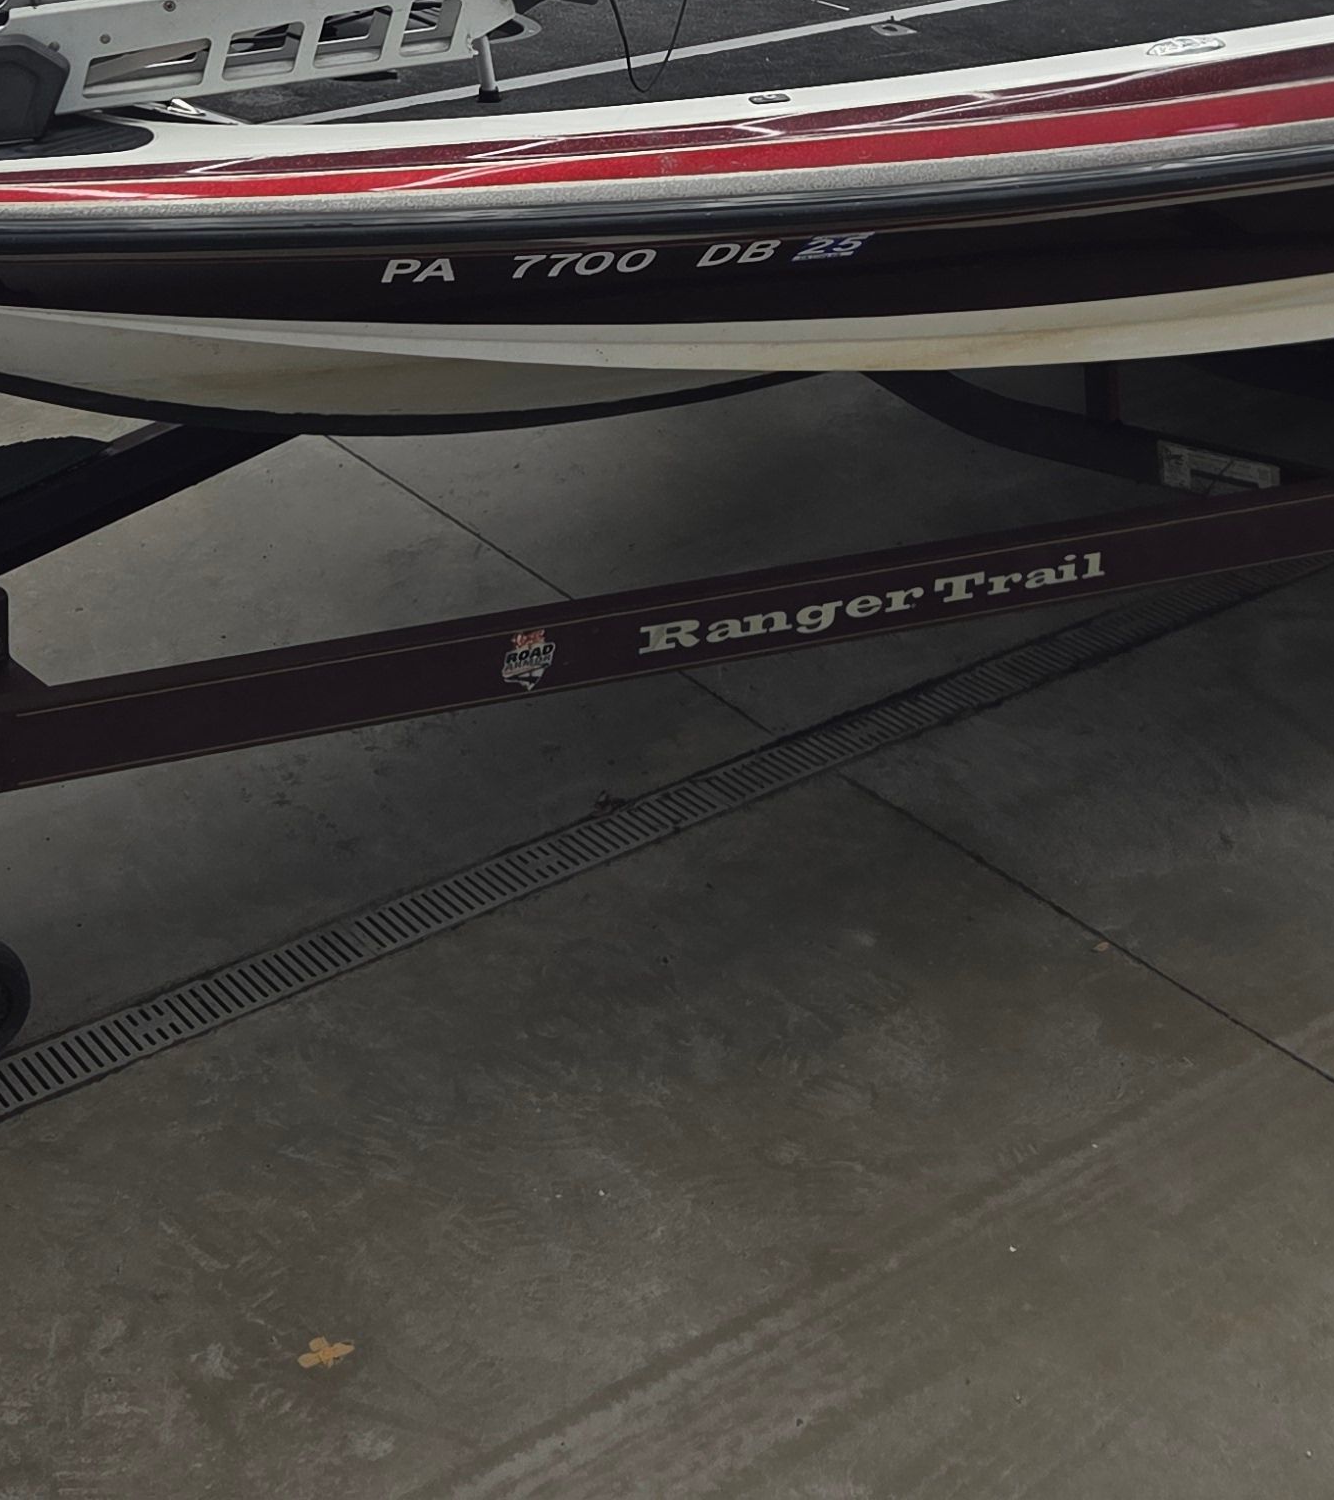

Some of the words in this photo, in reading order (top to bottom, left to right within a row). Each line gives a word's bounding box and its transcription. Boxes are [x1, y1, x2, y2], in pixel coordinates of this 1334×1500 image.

[380, 257, 456, 284] PA
[511, 248, 658, 280] 7700
[695, 239, 782, 268] DB
[796, 235, 870, 256] 25
[638, 585, 925, 655] Ranger
[933, 551, 1106, 605] Trail
[506, 643, 555, 664] ROAD
